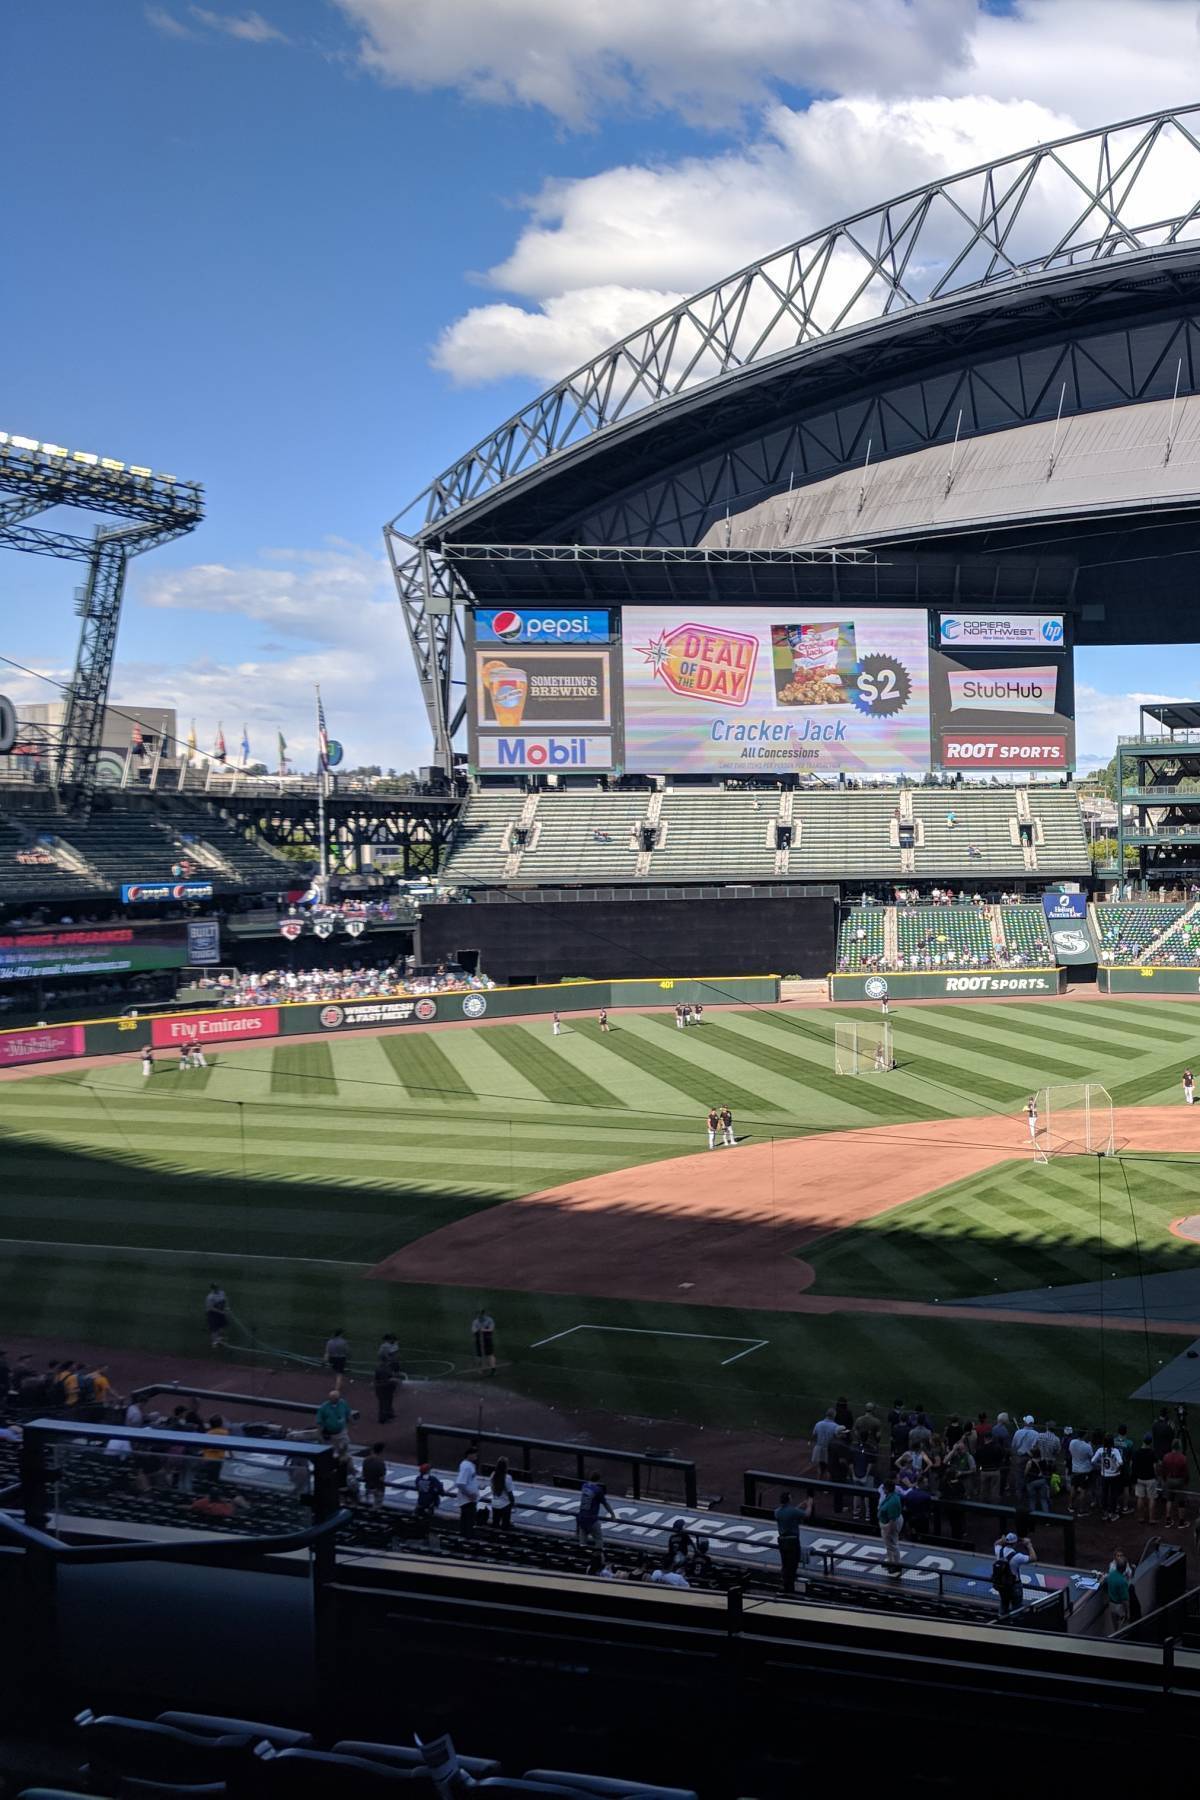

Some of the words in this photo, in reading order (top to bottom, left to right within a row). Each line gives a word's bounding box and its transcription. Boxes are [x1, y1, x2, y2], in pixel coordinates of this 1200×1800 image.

[527, 616, 589, 637] pepsi
[963, 621, 1011, 629] COPIERS
[963, 628, 1034, 636] NORTHWEST
[1044, 621, 1062, 641] hp
[683, 635, 747, 670] DEAL
[680, 662, 696, 677] OF
[531, 676, 597, 686] SOMETHING'S
[678, 676, 693, 688] THE
[696, 668, 745, 697] DAY
[856, 669, 900, 704] $2
[530, 687, 598, 697] BREWING
[963, 681, 1043, 699] StubHub
[711, 719, 794, 741] Cracker
[798, 719, 847, 741] Jack
[498, 738, 587, 765] Mobil
[741, 747, 755, 758] All
[757, 747, 820, 758] Concessions
[947, 744, 998, 758] ROOT
[190, 926, 216, 937] BUILT
[660, 980, 674, 989] 401
[946, 977, 991, 991] ROOT
[344, 1004, 382, 1015] WHERE
[382, 1003, 414, 1012] FRESH
[355, 1012, 382, 1022] FAST
[171, 1022, 197, 1038] Fly
[198, 1018, 262, 1034] Emirates
[598, 1506, 782, 1555] SAFECO
[809, 1537, 955, 1581] FIELD
